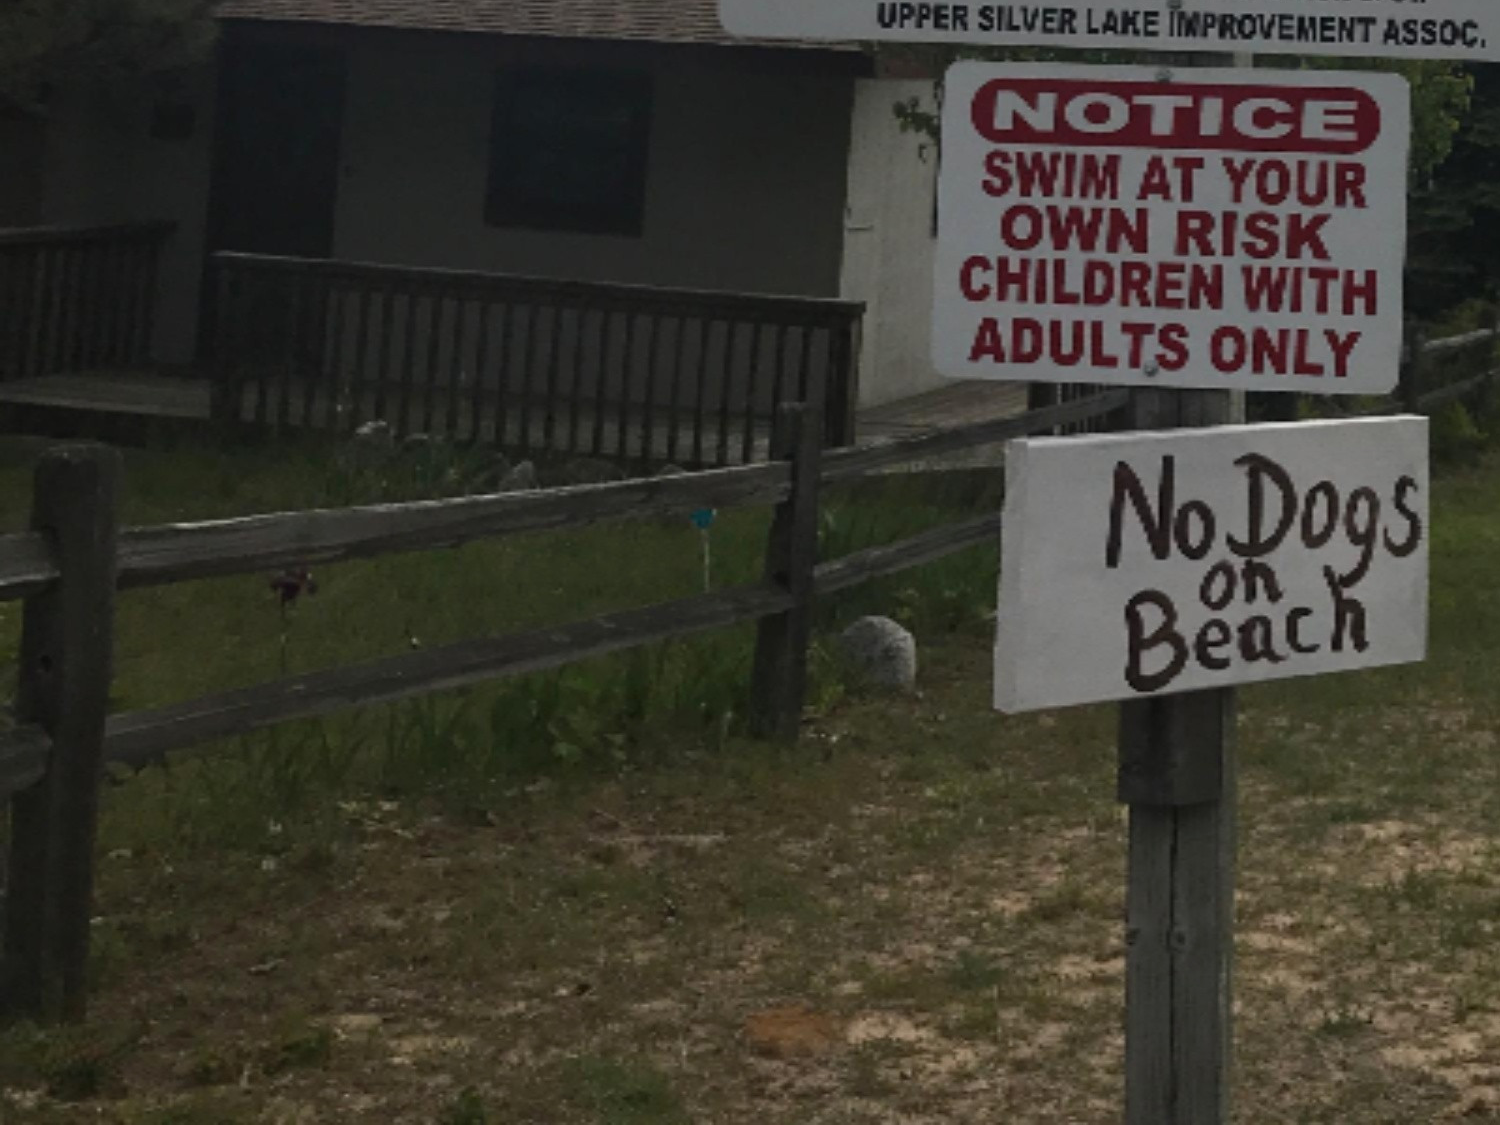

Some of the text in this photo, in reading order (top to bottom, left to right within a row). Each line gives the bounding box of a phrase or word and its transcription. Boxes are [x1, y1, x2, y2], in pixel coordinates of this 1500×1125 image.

[875, 2, 1486, 48] UPPER SILVER LAKE IMPROVEMENT ASSOC.
[993, 89, 1359, 141] NOTICE
[981, 150, 1367, 208] SWIM AT YOUR
[1000, 204, 1331, 260] OWN RISK
[960, 255, 1377, 316] CHILDREN WITH
[968, 317, 1362, 377] ADULTS ONLY
[1106, 453, 1422, 588] No Dogs
[1200, 559, 1284, 611] on
[1125, 565, 1369, 692] Beach
